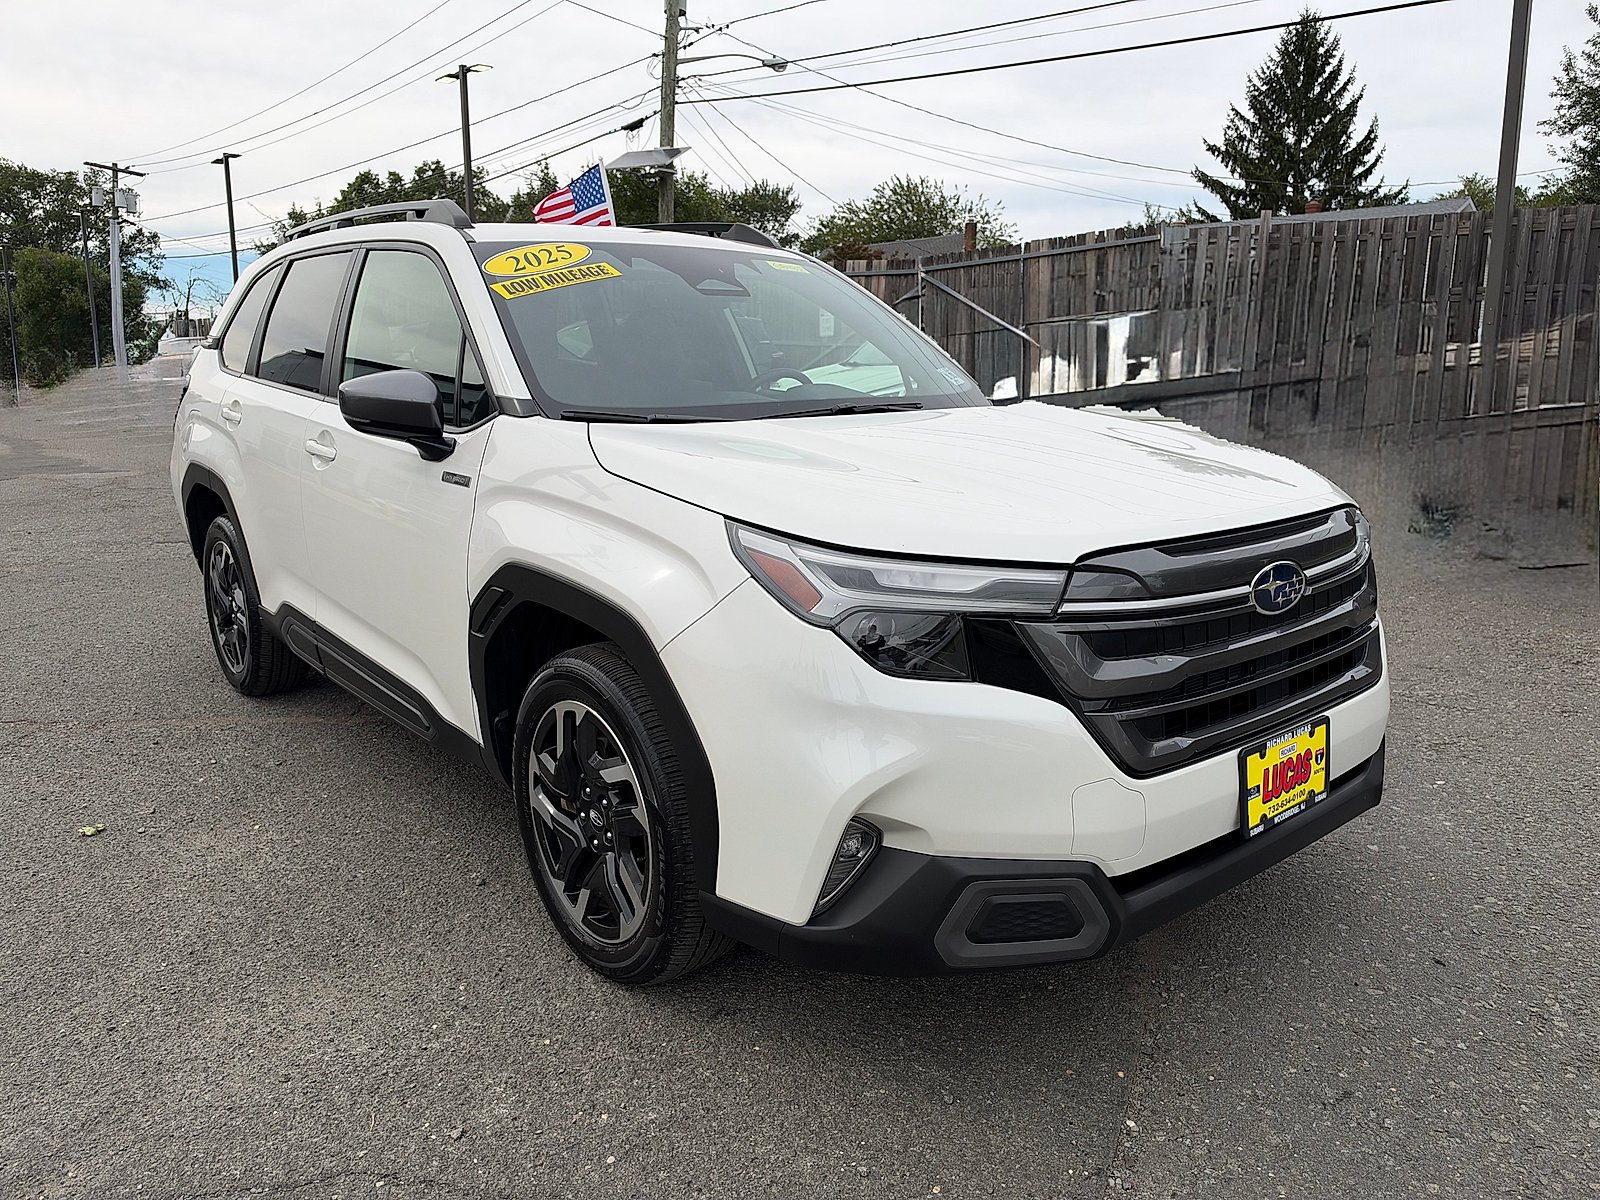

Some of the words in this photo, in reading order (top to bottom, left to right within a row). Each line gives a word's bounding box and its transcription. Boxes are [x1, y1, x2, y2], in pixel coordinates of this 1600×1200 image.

[505, 245, 573, 272] 2025
[501, 277, 541, 296] LOW
[540, 264, 610, 287] MILEAGE
[1266, 732, 1292, 749] RICHARD
[1293, 724, 1311, 739] LUCAS
[1280, 744, 1296, 757] RICHARD
[1261, 748, 1313, 804] LUCAS
[1267, 788, 1306, 816] 732-634-0100
[1300, 802, 1306, 811] NJ
